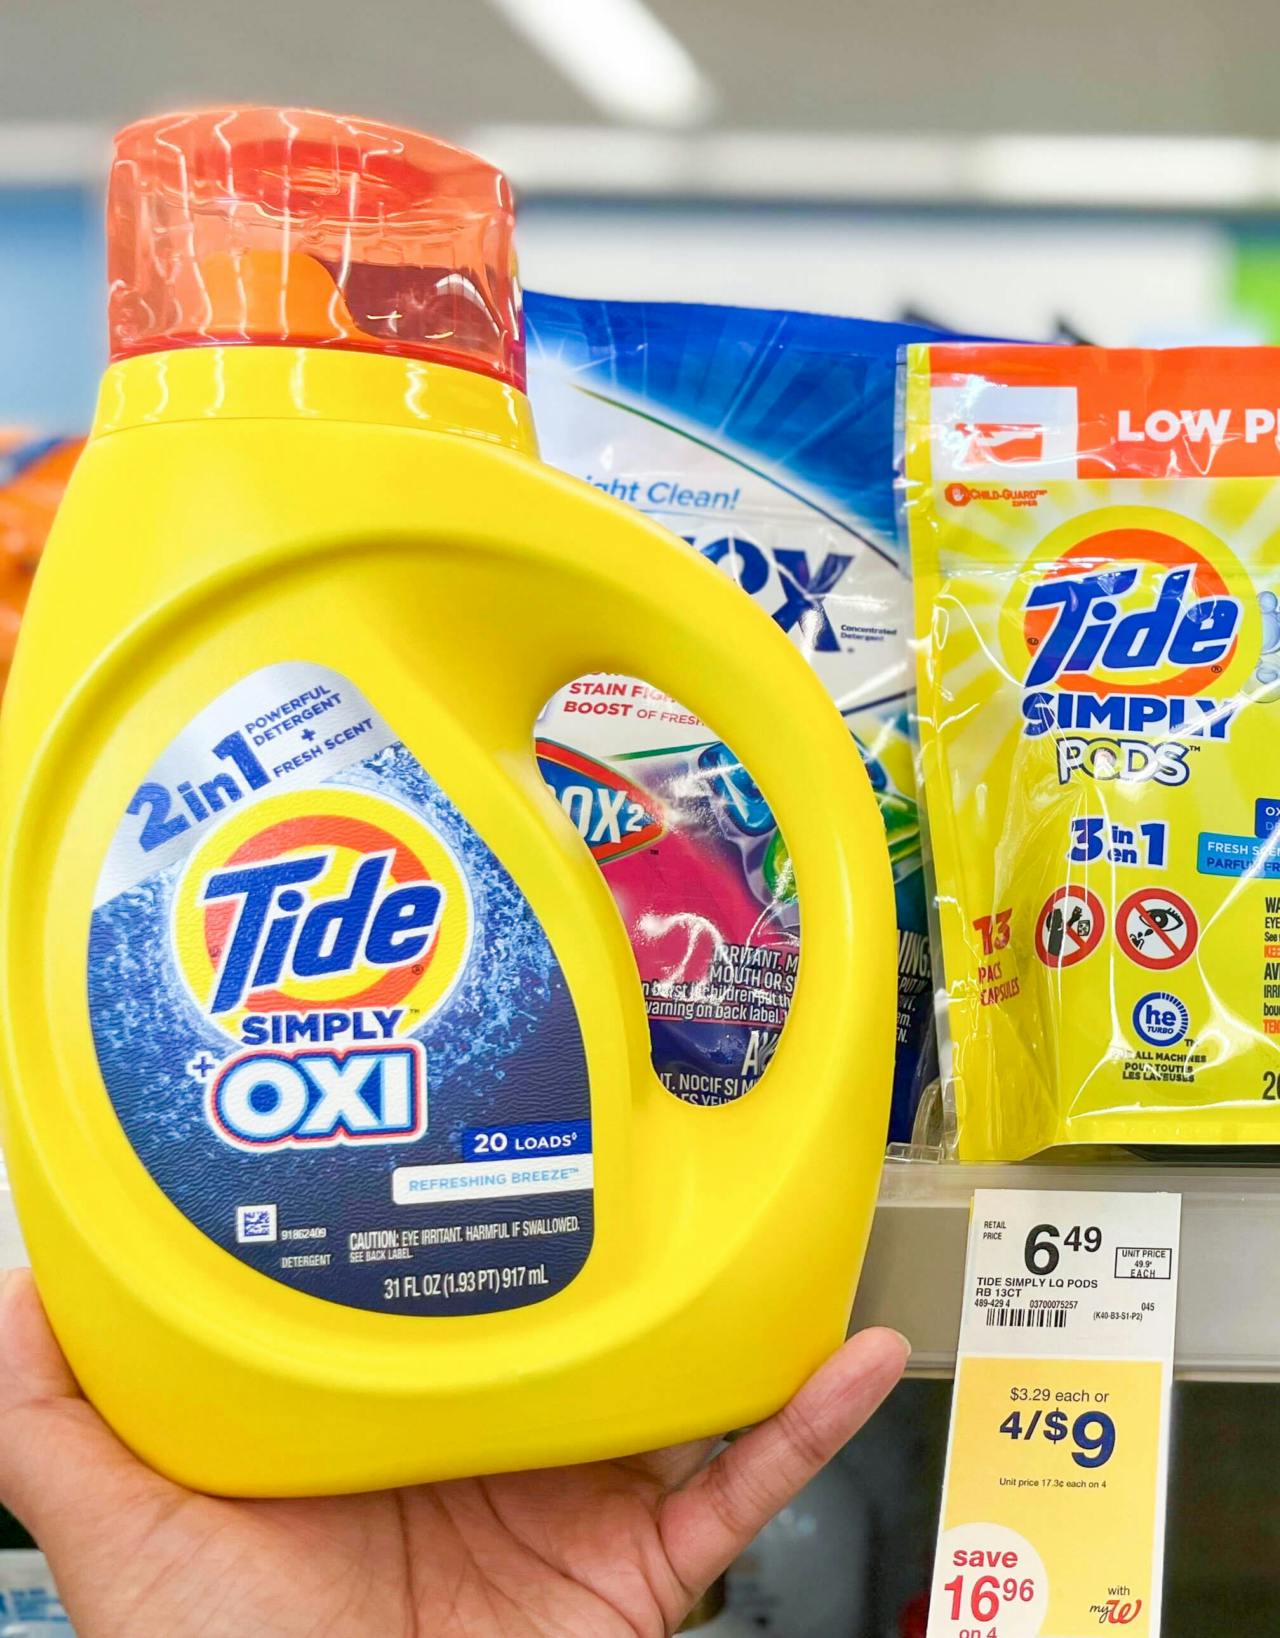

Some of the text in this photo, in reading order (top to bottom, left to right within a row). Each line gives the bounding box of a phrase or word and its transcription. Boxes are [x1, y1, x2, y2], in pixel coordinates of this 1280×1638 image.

[1118, 407, 1231, 444] LOW
[648, 481, 740, 510] Clean!
[1025, 568, 1239, 688] Tide
[569, 682, 627, 697] STAIN
[246, 684, 331, 734] POWERFUL
[564, 701, 657, 720] BOOST OF
[1022, 692, 1236, 739] SIMPLY
[253, 692, 342, 747] DETERGENT
[273, 718, 374, 778] FRESH SCENT
[1068, 818, 1166, 866] 3 1
[1207, 841, 1249, 855] FRESH
[203, 848, 442, 1013] Tide
[973, 908, 1014, 956] 13
[710, 965, 782, 990] MOUTH OR
[978, 961, 1003, 984] PACS
[980, 977, 1020, 1007] CAPSULES
[1145, 1004, 1177, 1026] he
[1147, 1026, 1174, 1035] TURBO
[1135, 1051, 1153, 1060] ALL
[679, 1073, 722, 1095] NOCIF
[217, 1050, 418, 1142] OXI
[474, 1133, 508, 1154] 20
[409, 1173, 507, 1193] REFRESHING
[350, 1216, 580, 1251] CAUTION: EYE IRRITANT. HARMFUL SWALLOWED.
[984, 1221, 1007, 1229] RETAIL
[983, 1232, 1002, 1240] PRICE
[281, 1254, 331, 1268] DETERGENT
[366, 1249, 386, 1262] BACK
[1121, 1249, 1166, 1258] UNIT PRICE
[384, 1264, 549, 1299] 31 FL OZ (1.93 PT) 917 mL
[977, 1277, 1098, 1288] TIDE SIMPLY LQ PODS
[1130, 1269, 1156, 1278] EACH
[976, 1289, 1022, 1298] RB 13CT
[1029, 1300, 1078, 1310] 03700075257
[1010, 1387, 1109, 1403] $3.29 each or
[999, 1477, 1086, 1488] Unit price each
[952, 1550, 1018, 1568] save
[1108, 1585, 1130, 1596] with
